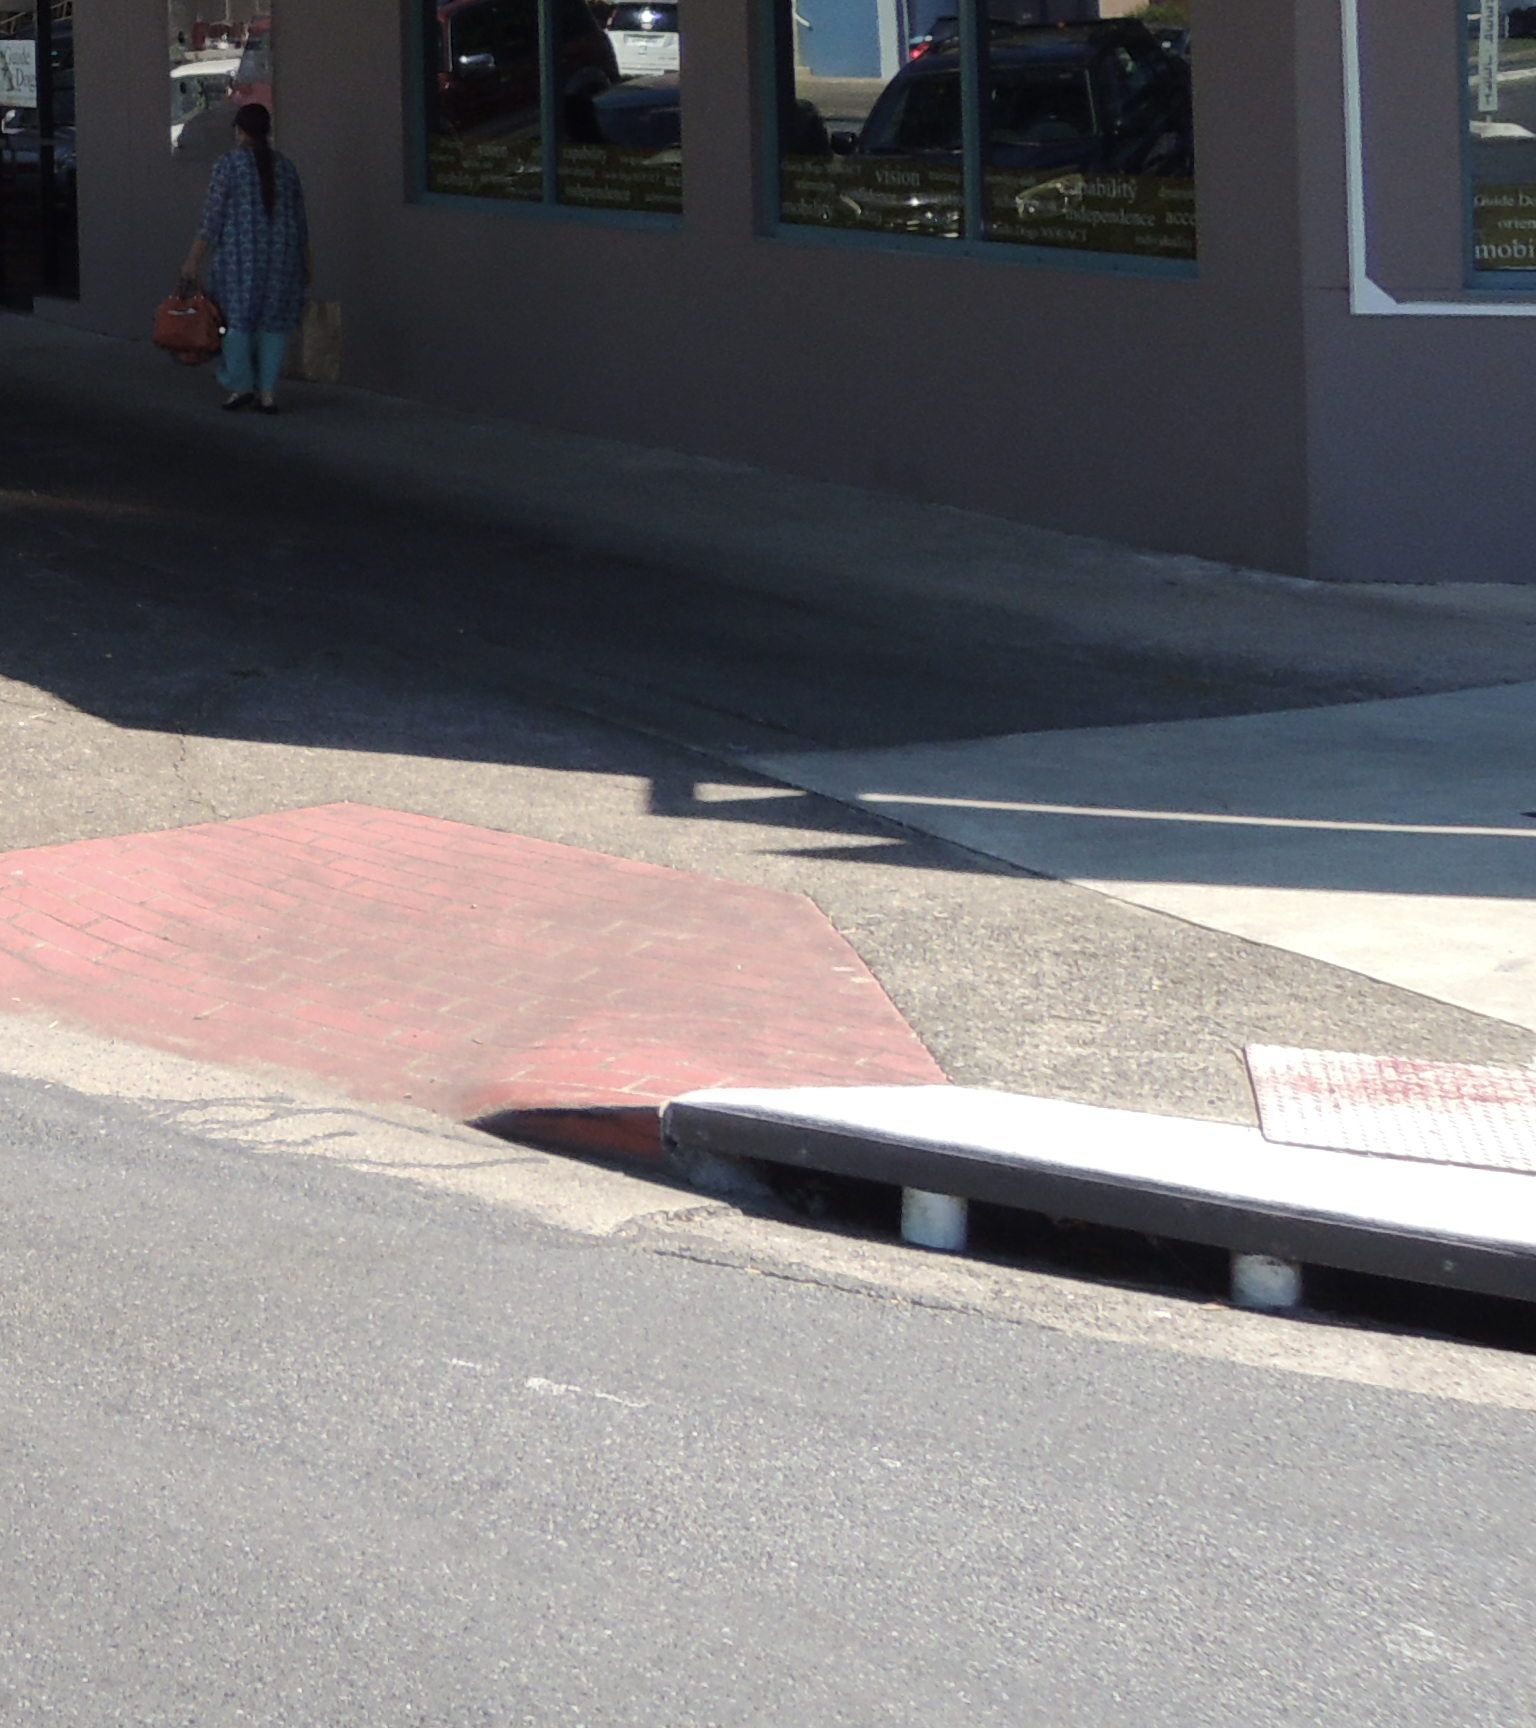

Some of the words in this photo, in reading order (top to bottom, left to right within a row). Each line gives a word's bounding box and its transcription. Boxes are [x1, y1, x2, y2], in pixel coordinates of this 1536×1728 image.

[16, 68, 37, 93] Dog
[874, 167, 921, 186] vision
[1065, 177, 1138, 204] pability
[1473, 193, 1515, 207] Guide
[1064, 208, 1156, 229] independence
[1475, 238, 1535, 259] mobi
